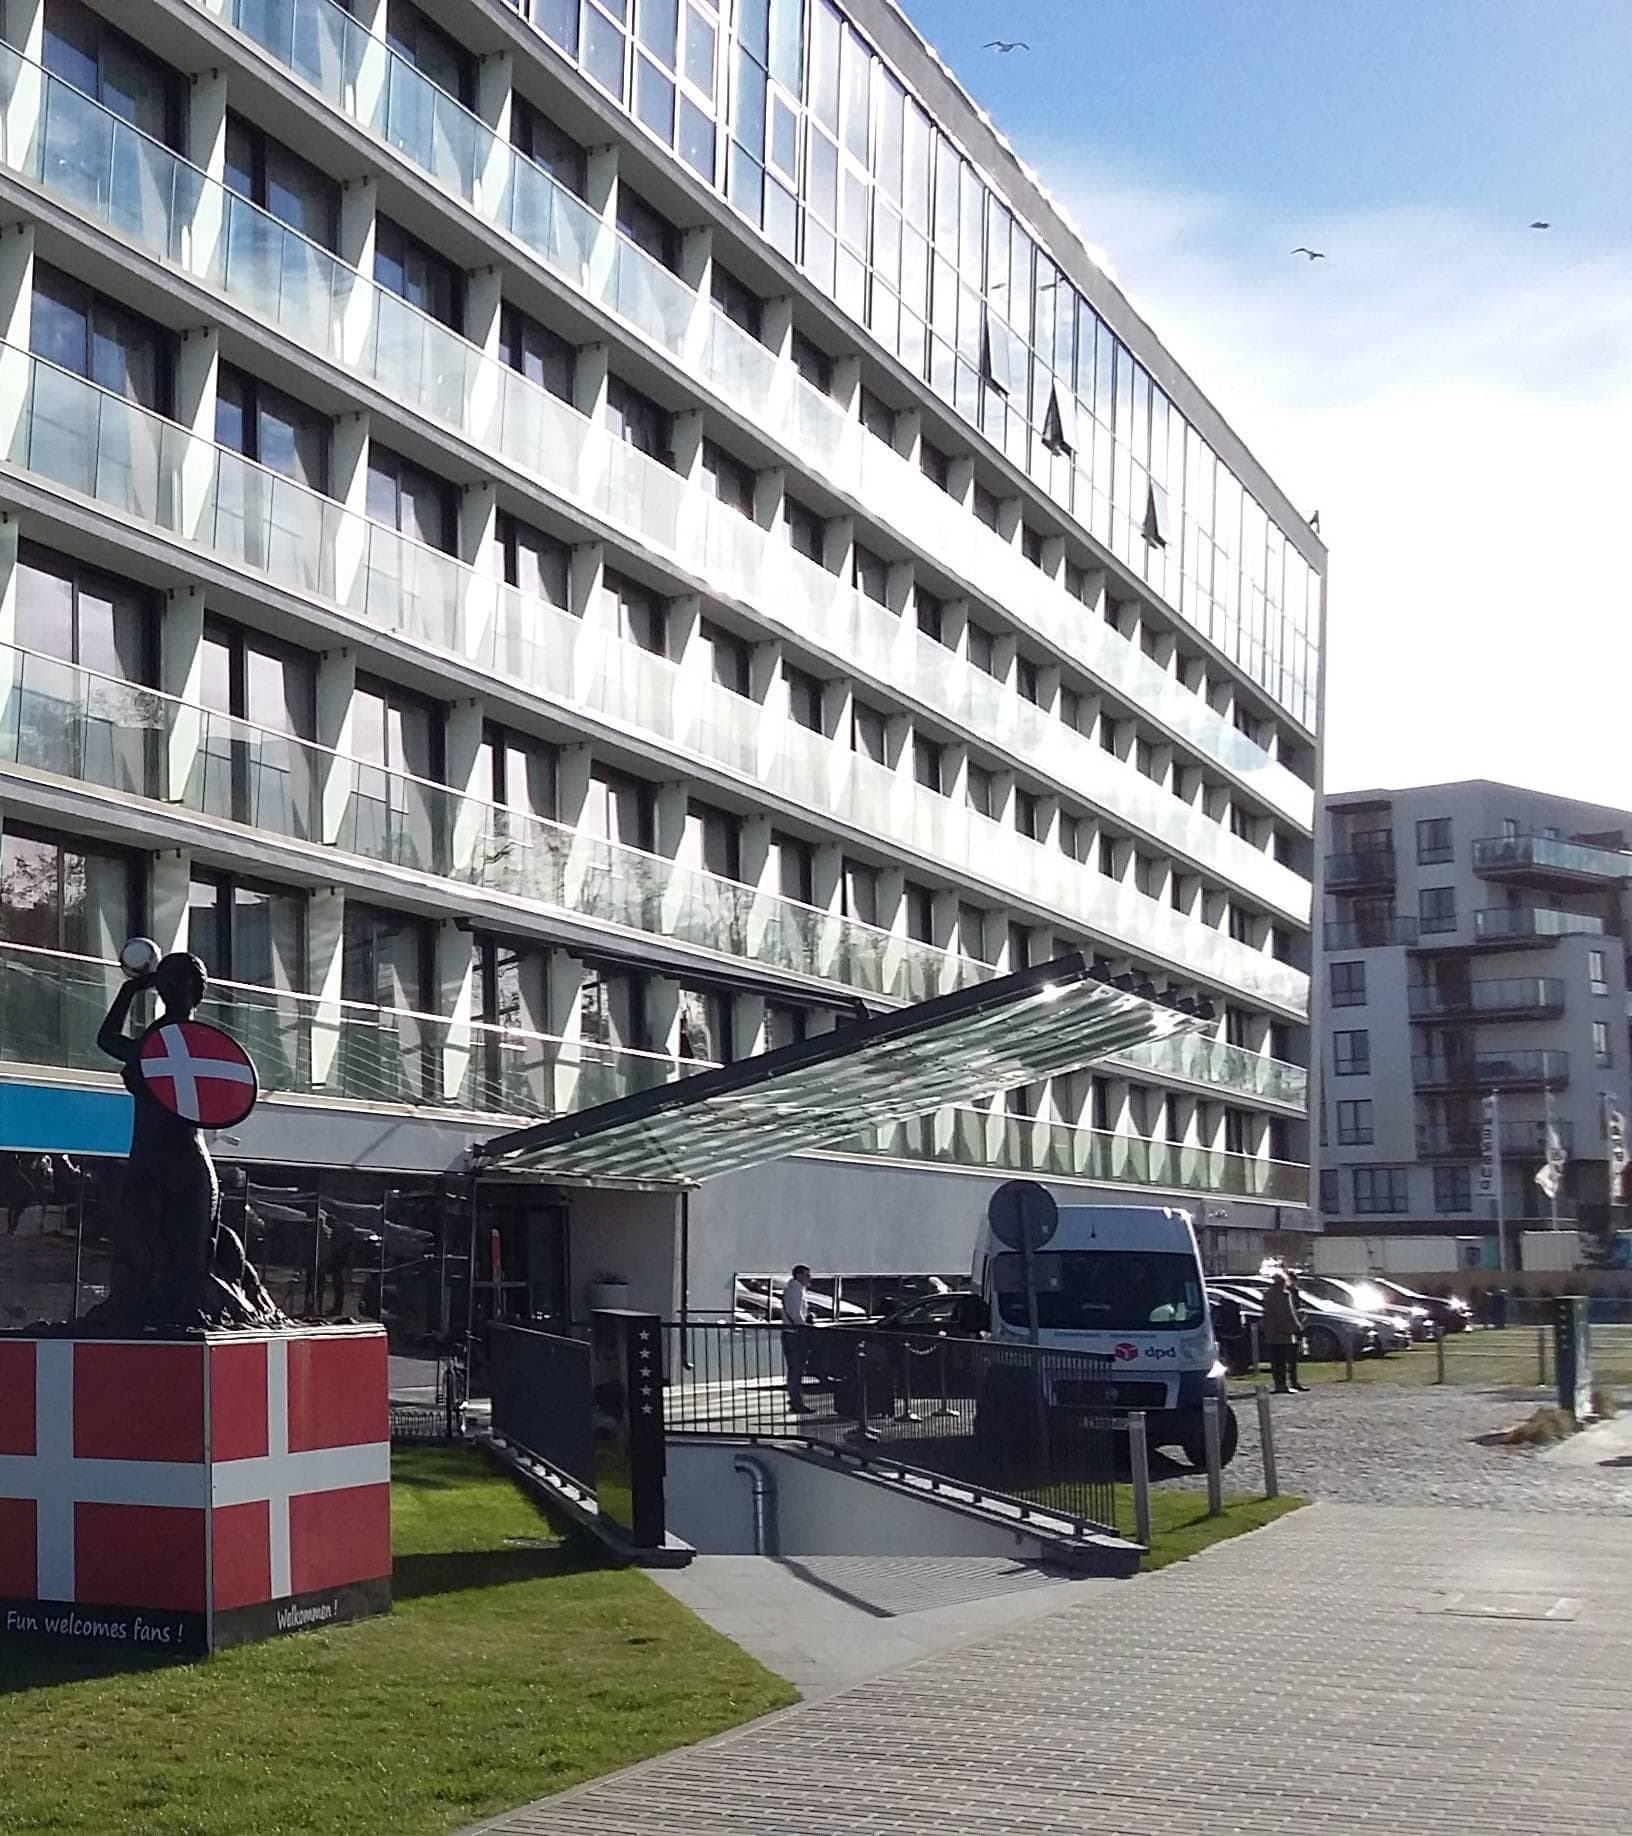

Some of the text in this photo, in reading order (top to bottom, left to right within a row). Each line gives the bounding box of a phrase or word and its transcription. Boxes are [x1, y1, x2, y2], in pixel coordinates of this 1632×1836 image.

[1144, 1346, 1177, 1361] dpd
[5, 1610, 39, 1632] Fun
[44, 1612, 127, 1640] welcomes
[133, 1617, 171, 1643] fans
